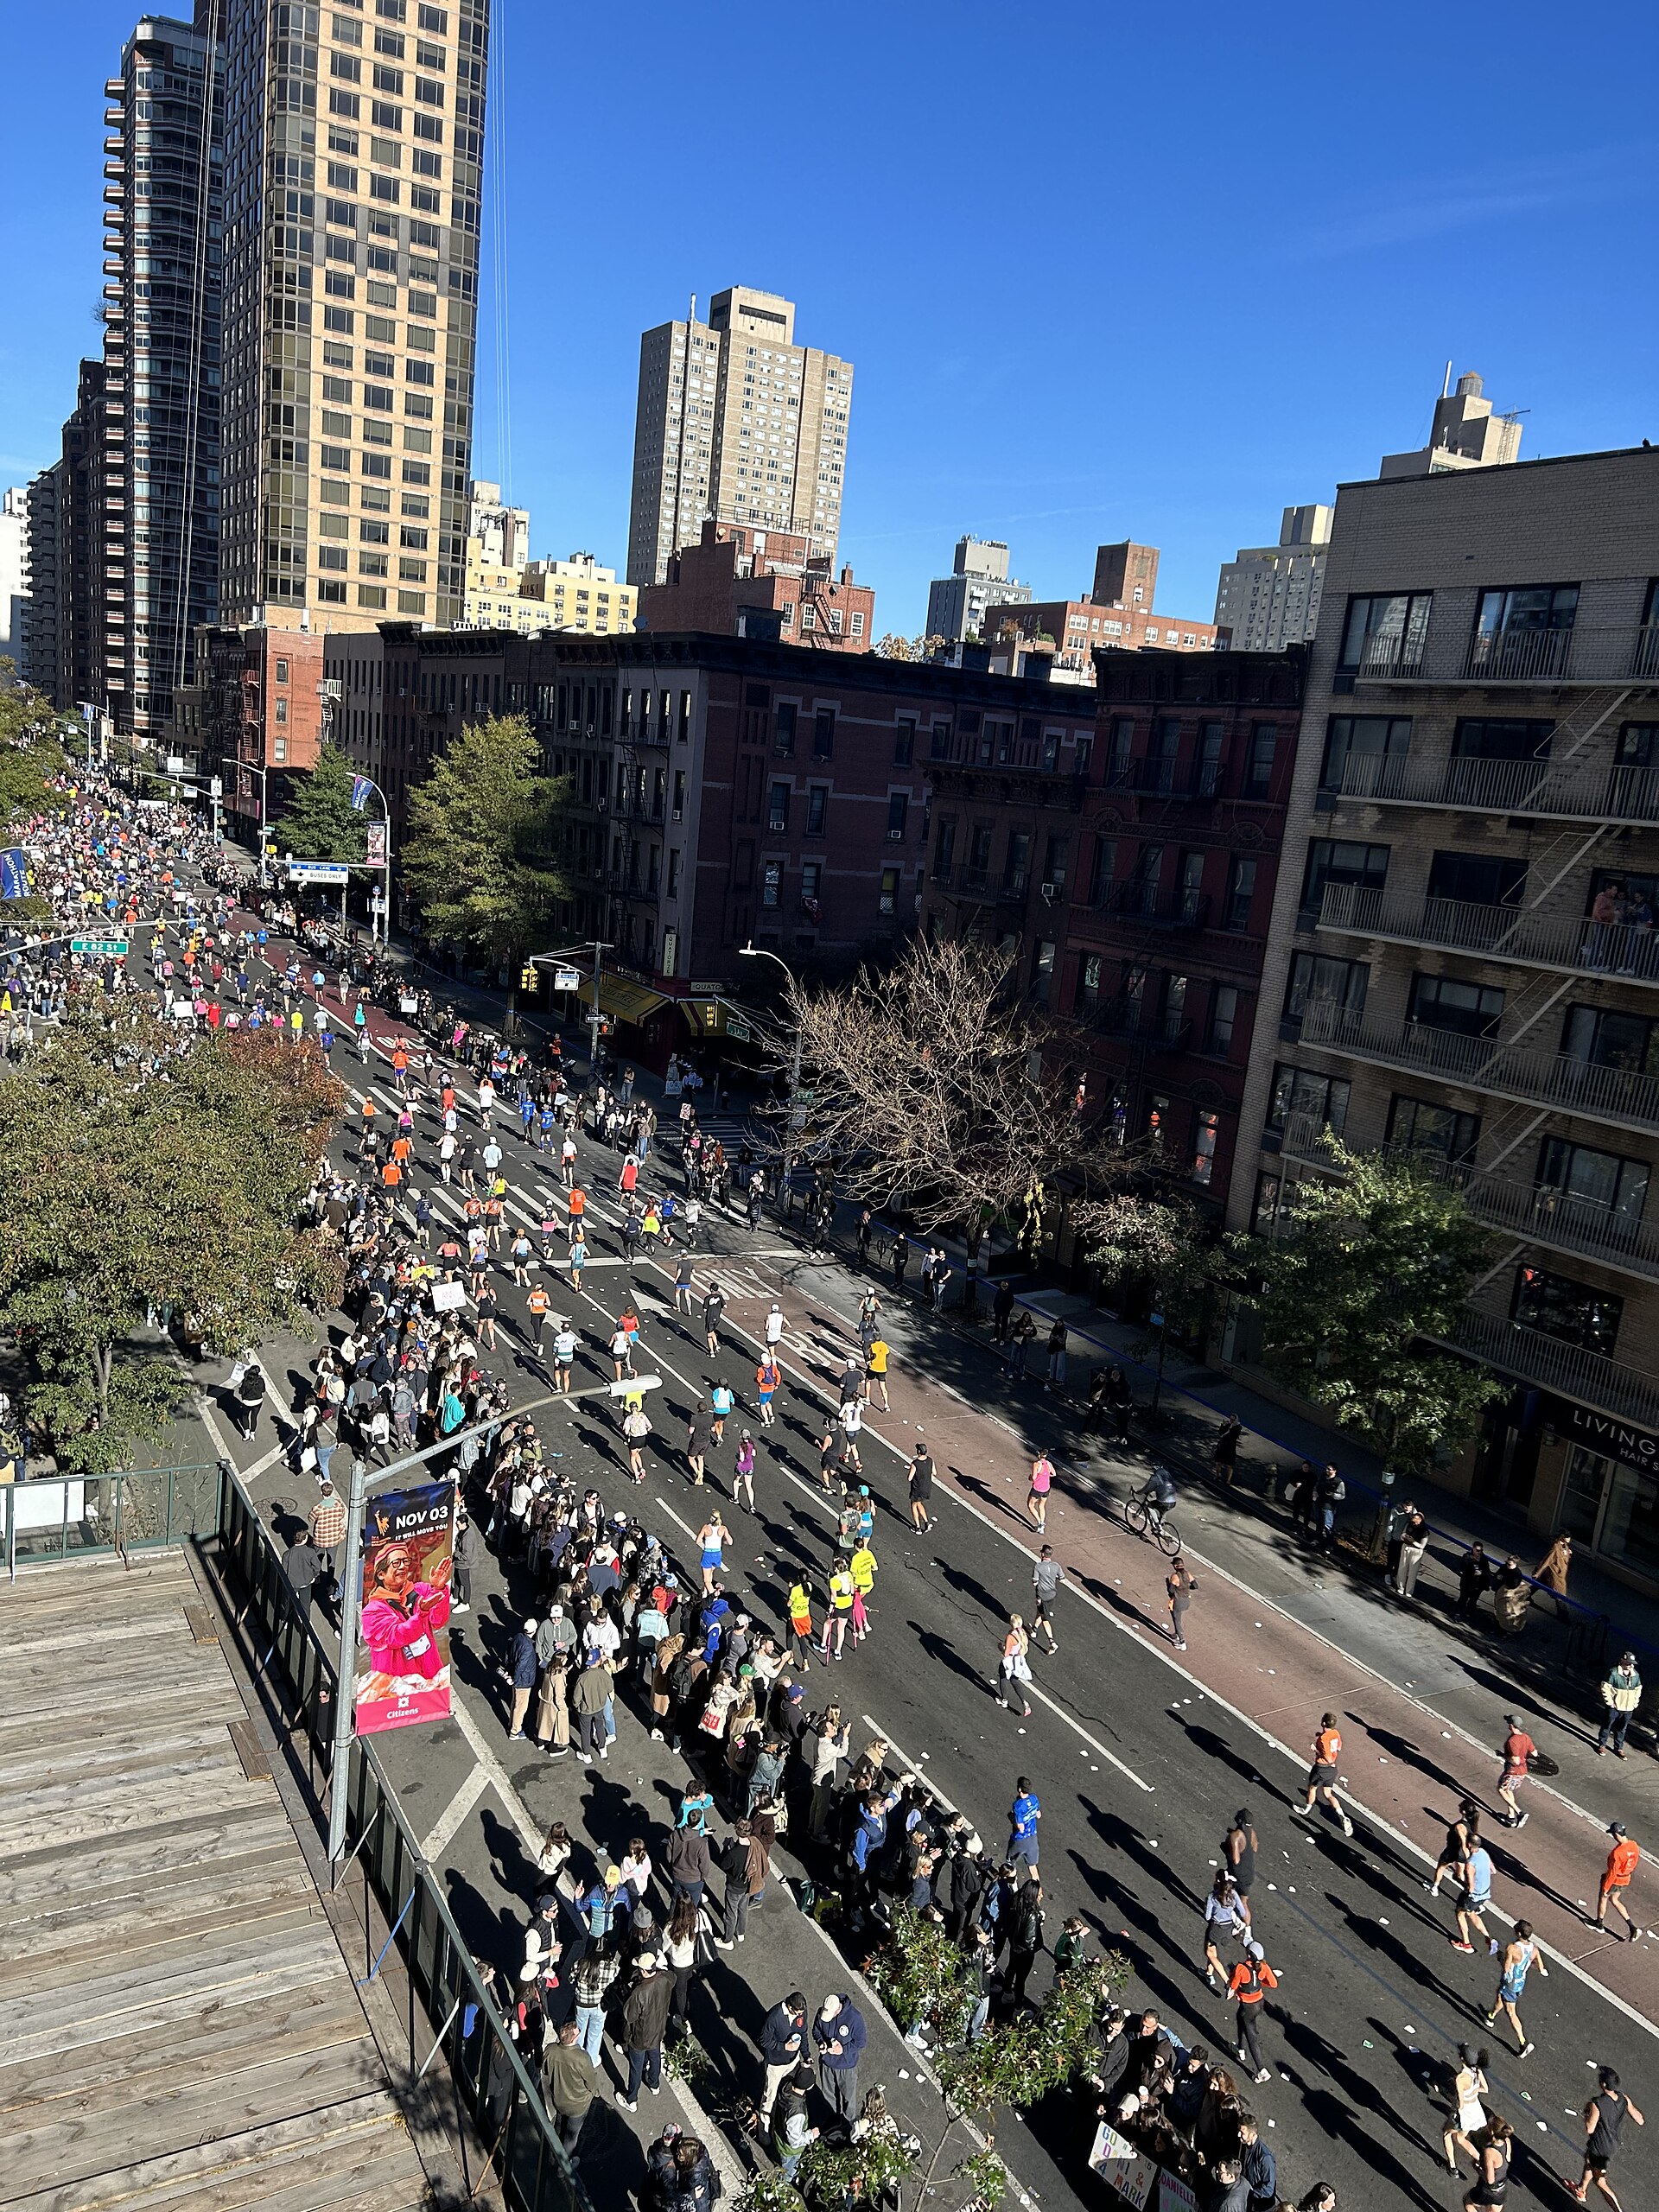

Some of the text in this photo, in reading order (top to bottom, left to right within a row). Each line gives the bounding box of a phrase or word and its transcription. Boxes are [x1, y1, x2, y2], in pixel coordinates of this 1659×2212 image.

[3, 854, 22, 898] MARATHON
[20, 869, 31, 898] ROUTE
[91, 943, 104, 951] 82
[691, 1268, 783, 1300] ONLY
[781, 1328, 864, 1367] BUS
[1573, 1410, 1656, 1455] LIVING
[1619, 1447, 1648, 1466] HAIR
[396, 1505, 448, 1530] NOV 03
[403, 1530, 416, 1540] WILL
[416, 1526, 435, 1536] MOVE
[435, 1522, 448, 1532] YOU
[386, 1707, 419, 1719] Citizens
[1103, 2126, 1118, 2146] GO
[1114, 2173, 1146, 2209] MARK
[1160, 2173, 1195, 2207] DANIELLE
